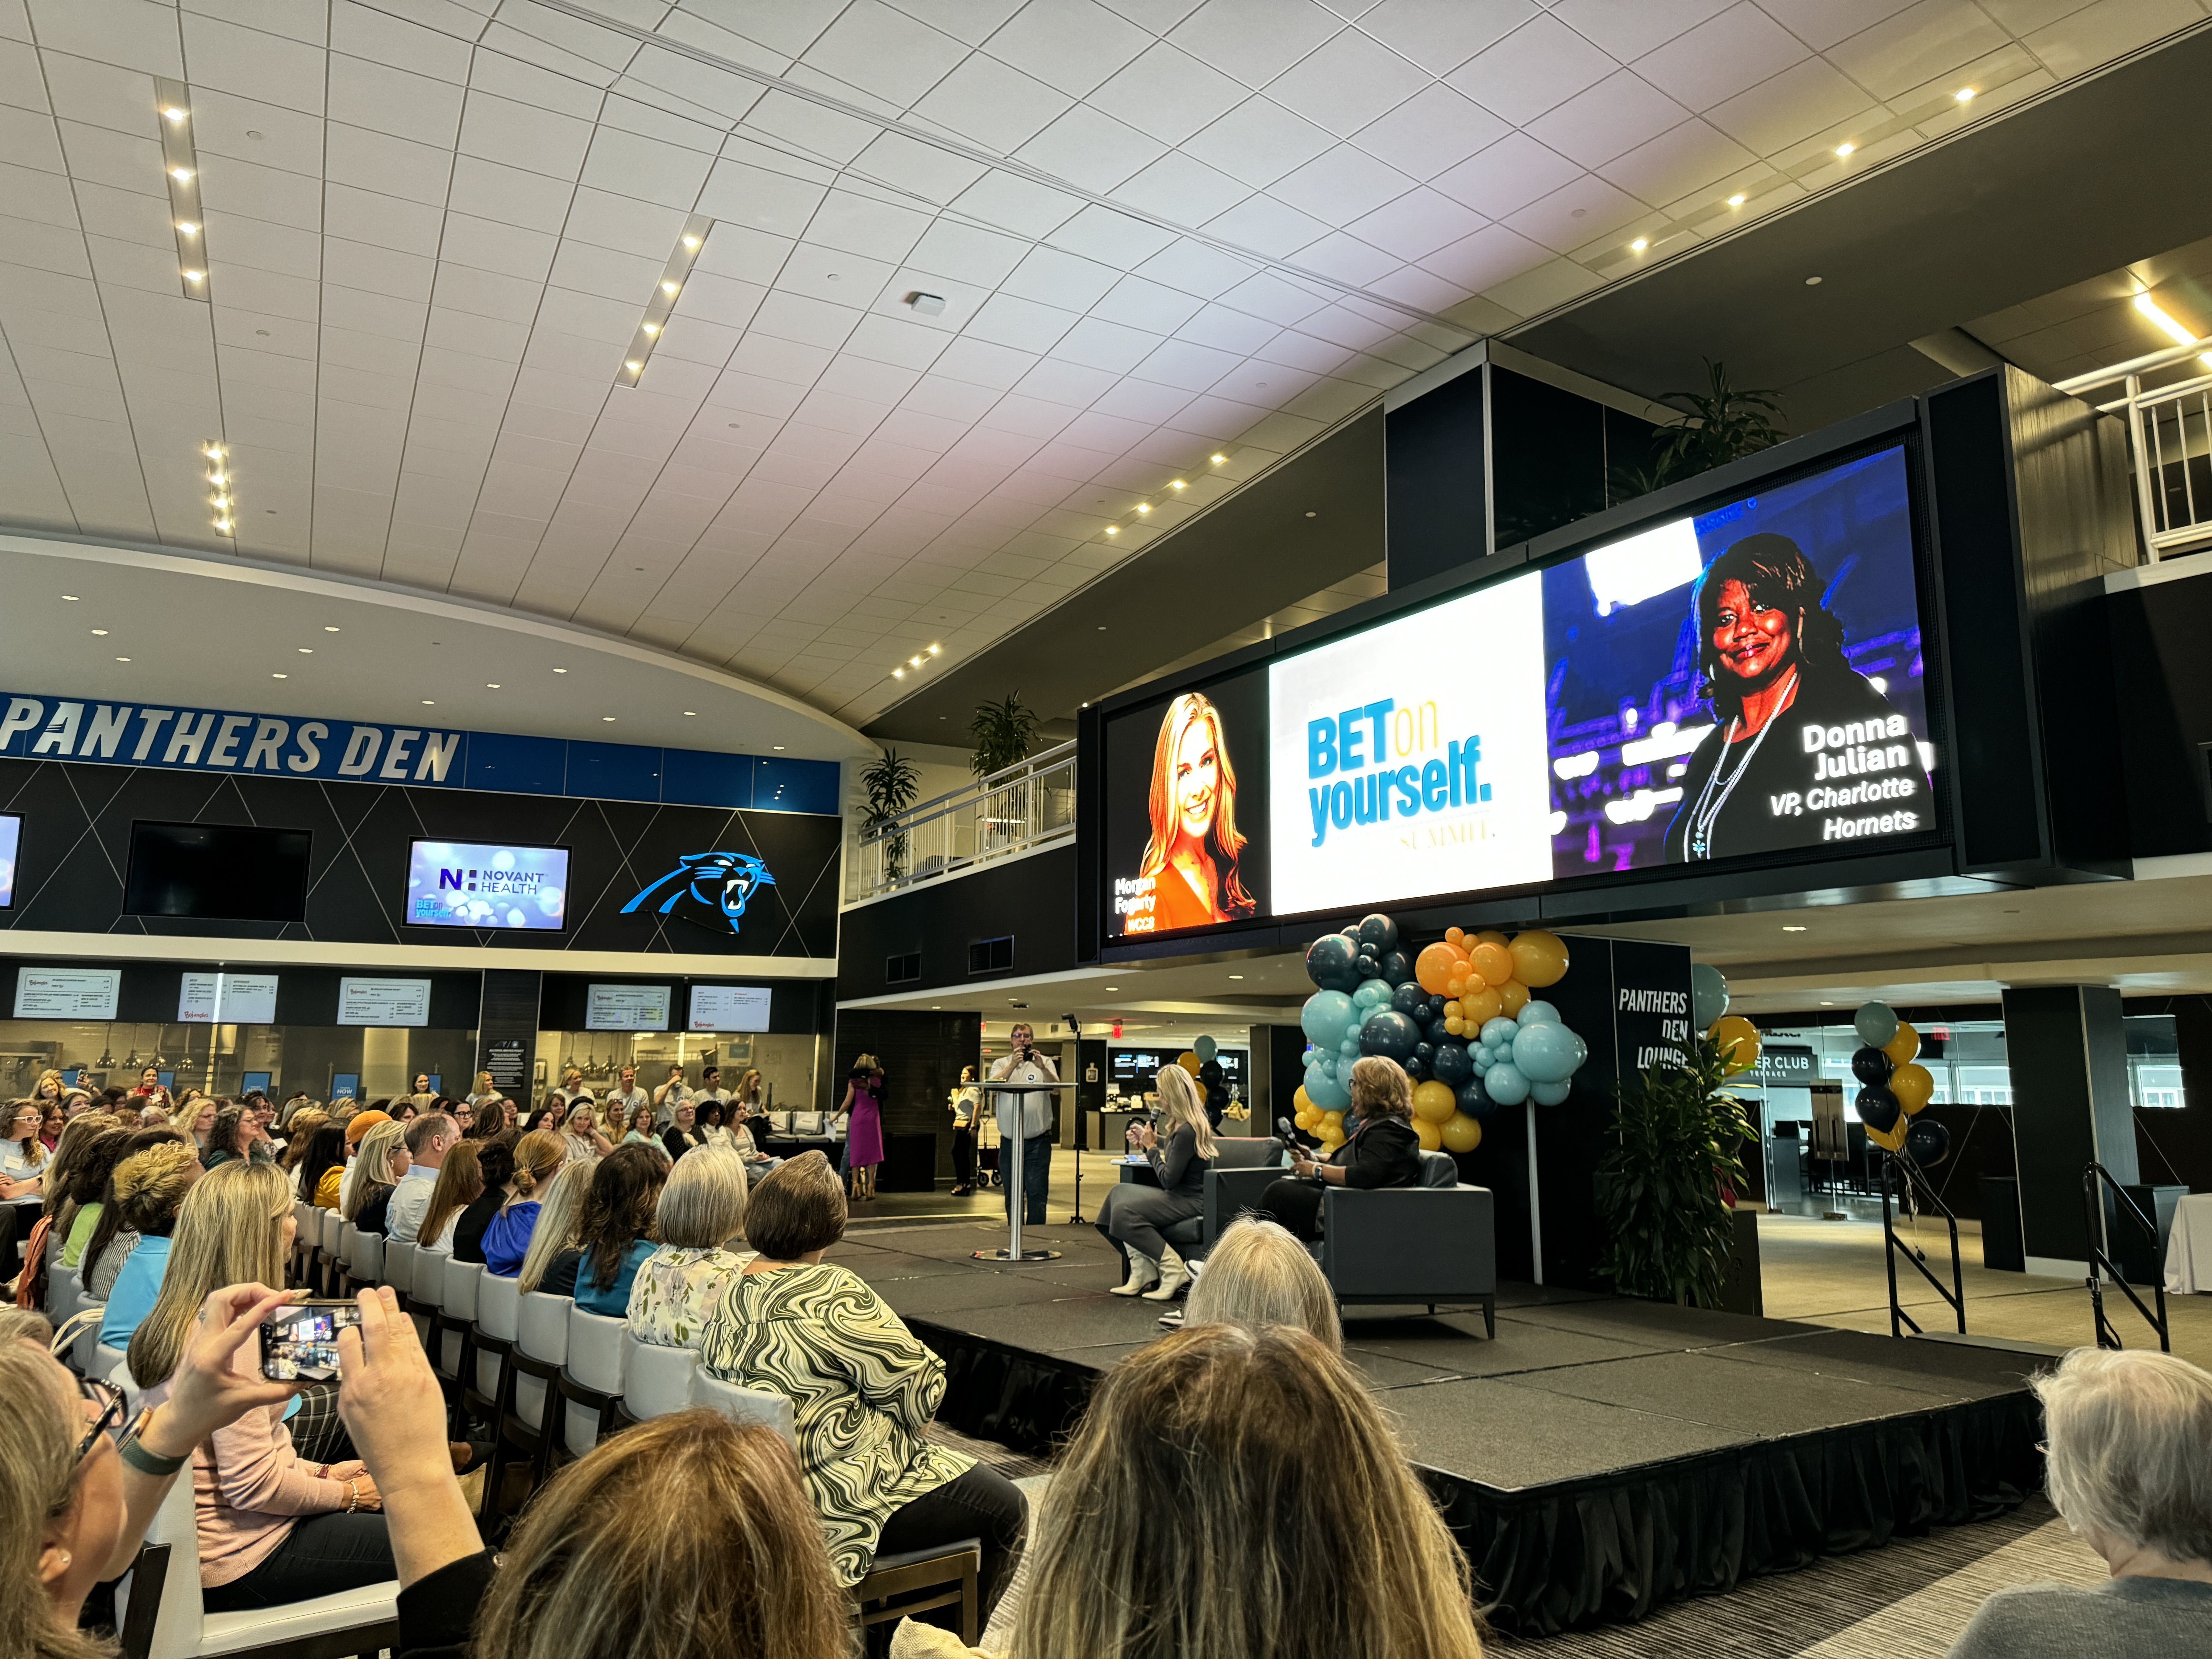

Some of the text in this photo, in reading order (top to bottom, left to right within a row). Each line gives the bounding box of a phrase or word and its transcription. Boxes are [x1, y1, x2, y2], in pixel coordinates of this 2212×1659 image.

[0, 698, 460, 782] PANTHERS DEN
[1309, 698, 1438, 779] BET on
[1803, 714, 1907, 753] Donna
[1815, 745, 1908, 781] Julian
[1309, 735, 1492, 847] yourself.
[1771, 778, 1915, 816] VP, Charlotte
[1824, 811, 1917, 840] Hornets
[481, 882, 537, 895] HEALTH
[483, 870, 544, 883] NOVANT
[1115, 877, 1156, 896] Morgan
[416, 899, 434, 909] BET
[1619, 988, 1687, 1014] PANTHERS
[1662, 1019, 1688, 1042] DEN
[1755, 1056, 1809, 1069] ER CLUB
